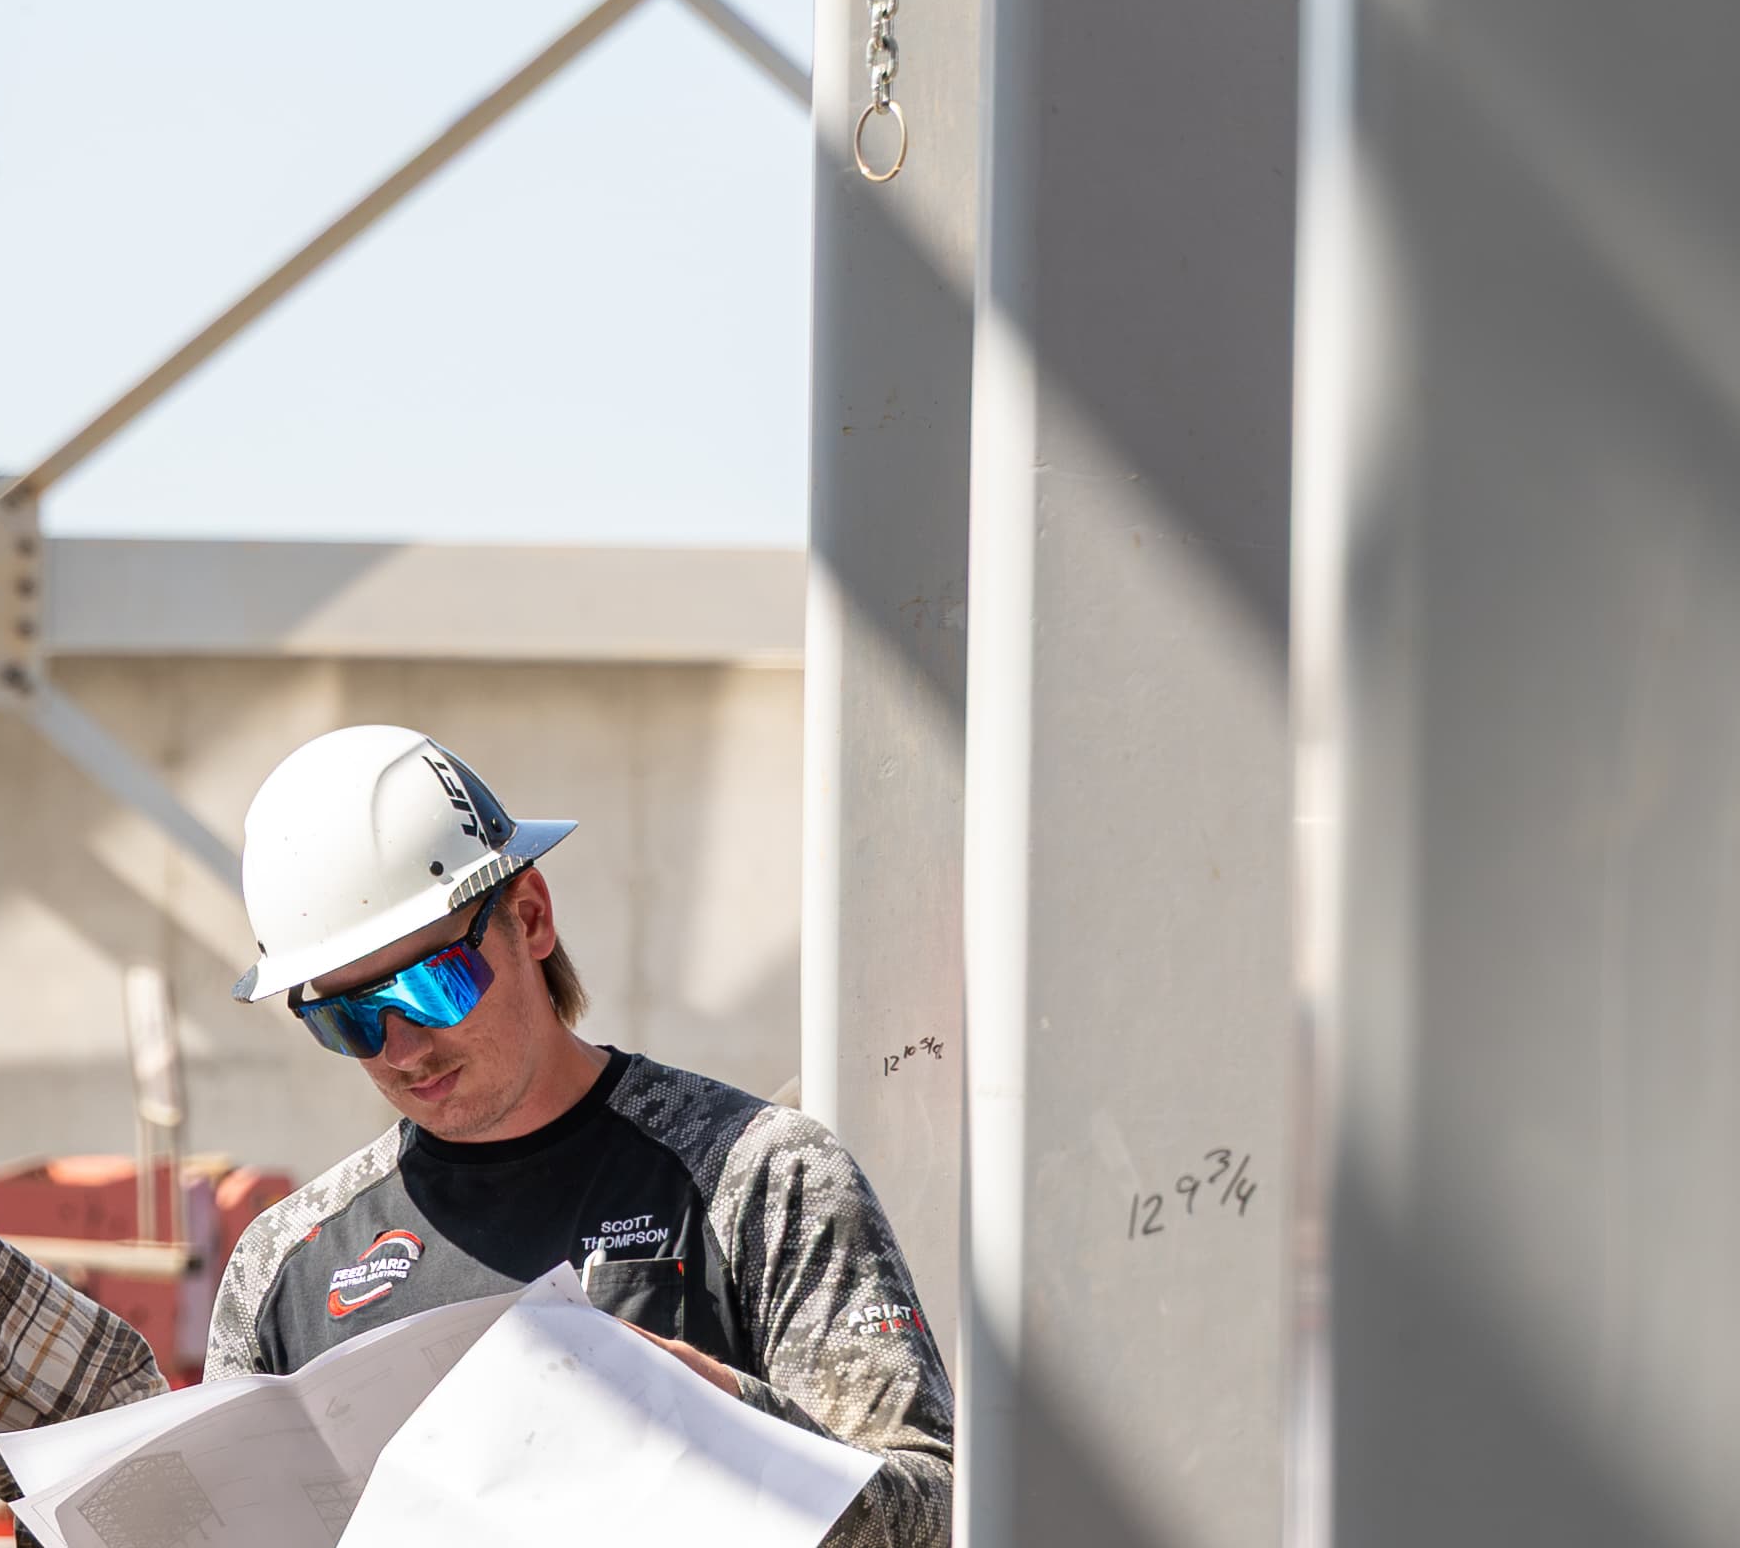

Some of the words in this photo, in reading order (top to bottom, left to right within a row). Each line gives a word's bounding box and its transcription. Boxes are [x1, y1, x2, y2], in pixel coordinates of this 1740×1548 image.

[421, 755, 478, 837] LIFT
[601, 1215, 653, 1233] SCOTT
[1128, 1192, 1164, 1241] 12
[581, 1227, 668, 1250] THOMPSON
[333, 1265, 367, 1282] FEED
[370, 1258, 411, 1273] YARD
[848, 1304, 912, 1328] ARIAT
